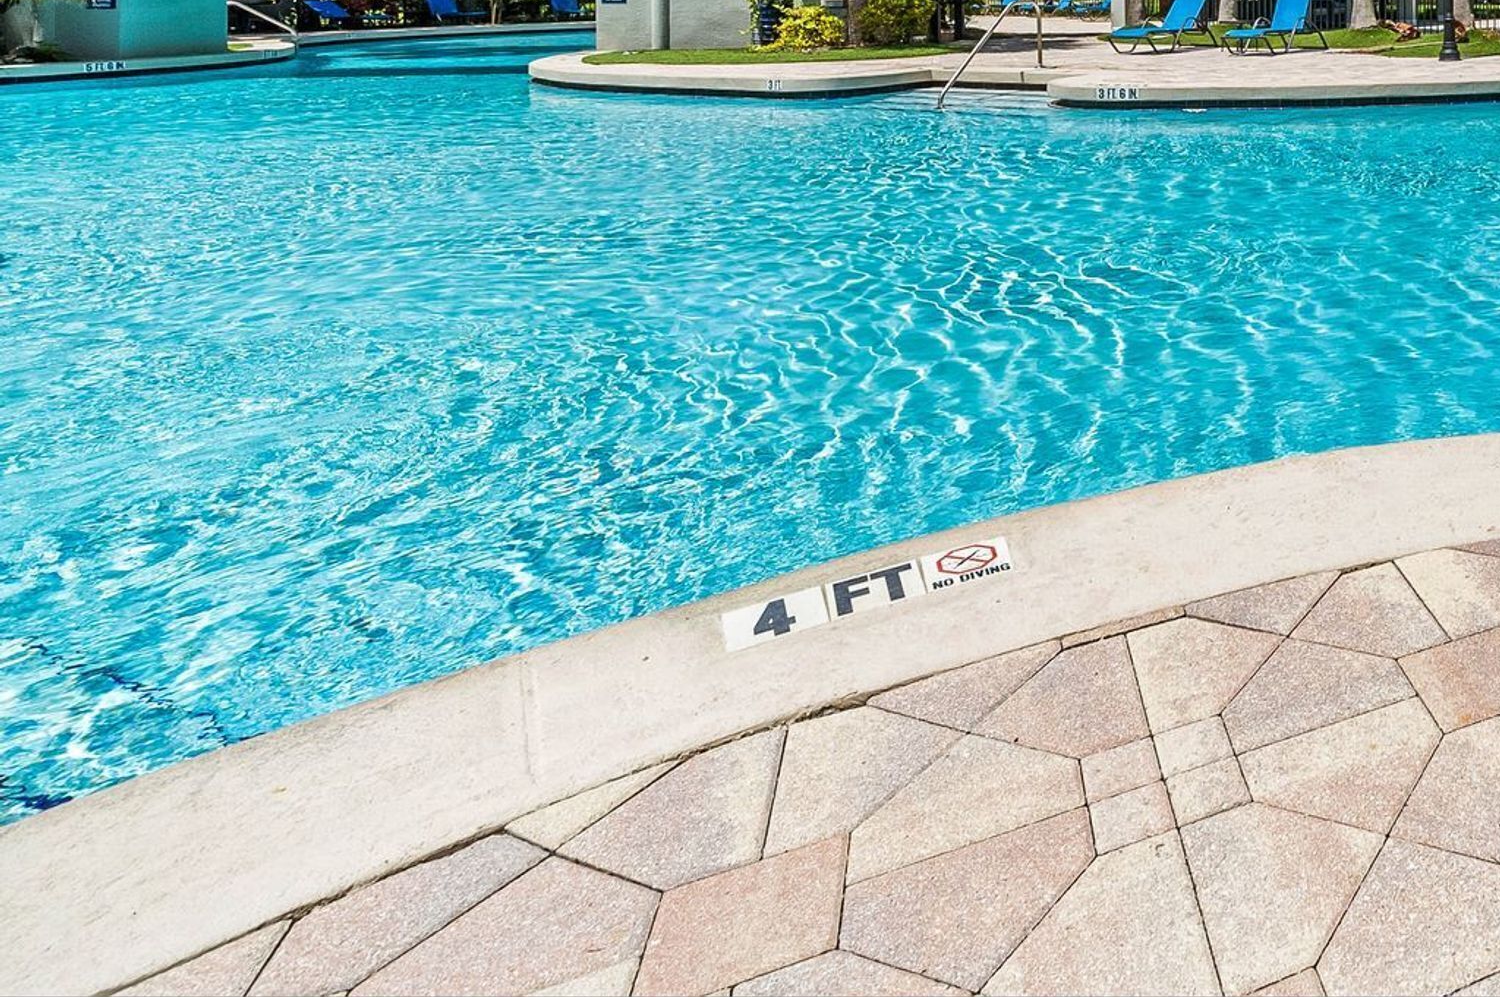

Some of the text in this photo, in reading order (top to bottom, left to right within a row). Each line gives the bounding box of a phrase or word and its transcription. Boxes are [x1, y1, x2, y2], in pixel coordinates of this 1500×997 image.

[1098, 87, 1105, 100] 3
[1119, 87, 1126, 100] 6
[932, 562, 1011, 591] NO DIVING
[753, 563, 912, 636] 4 FT
